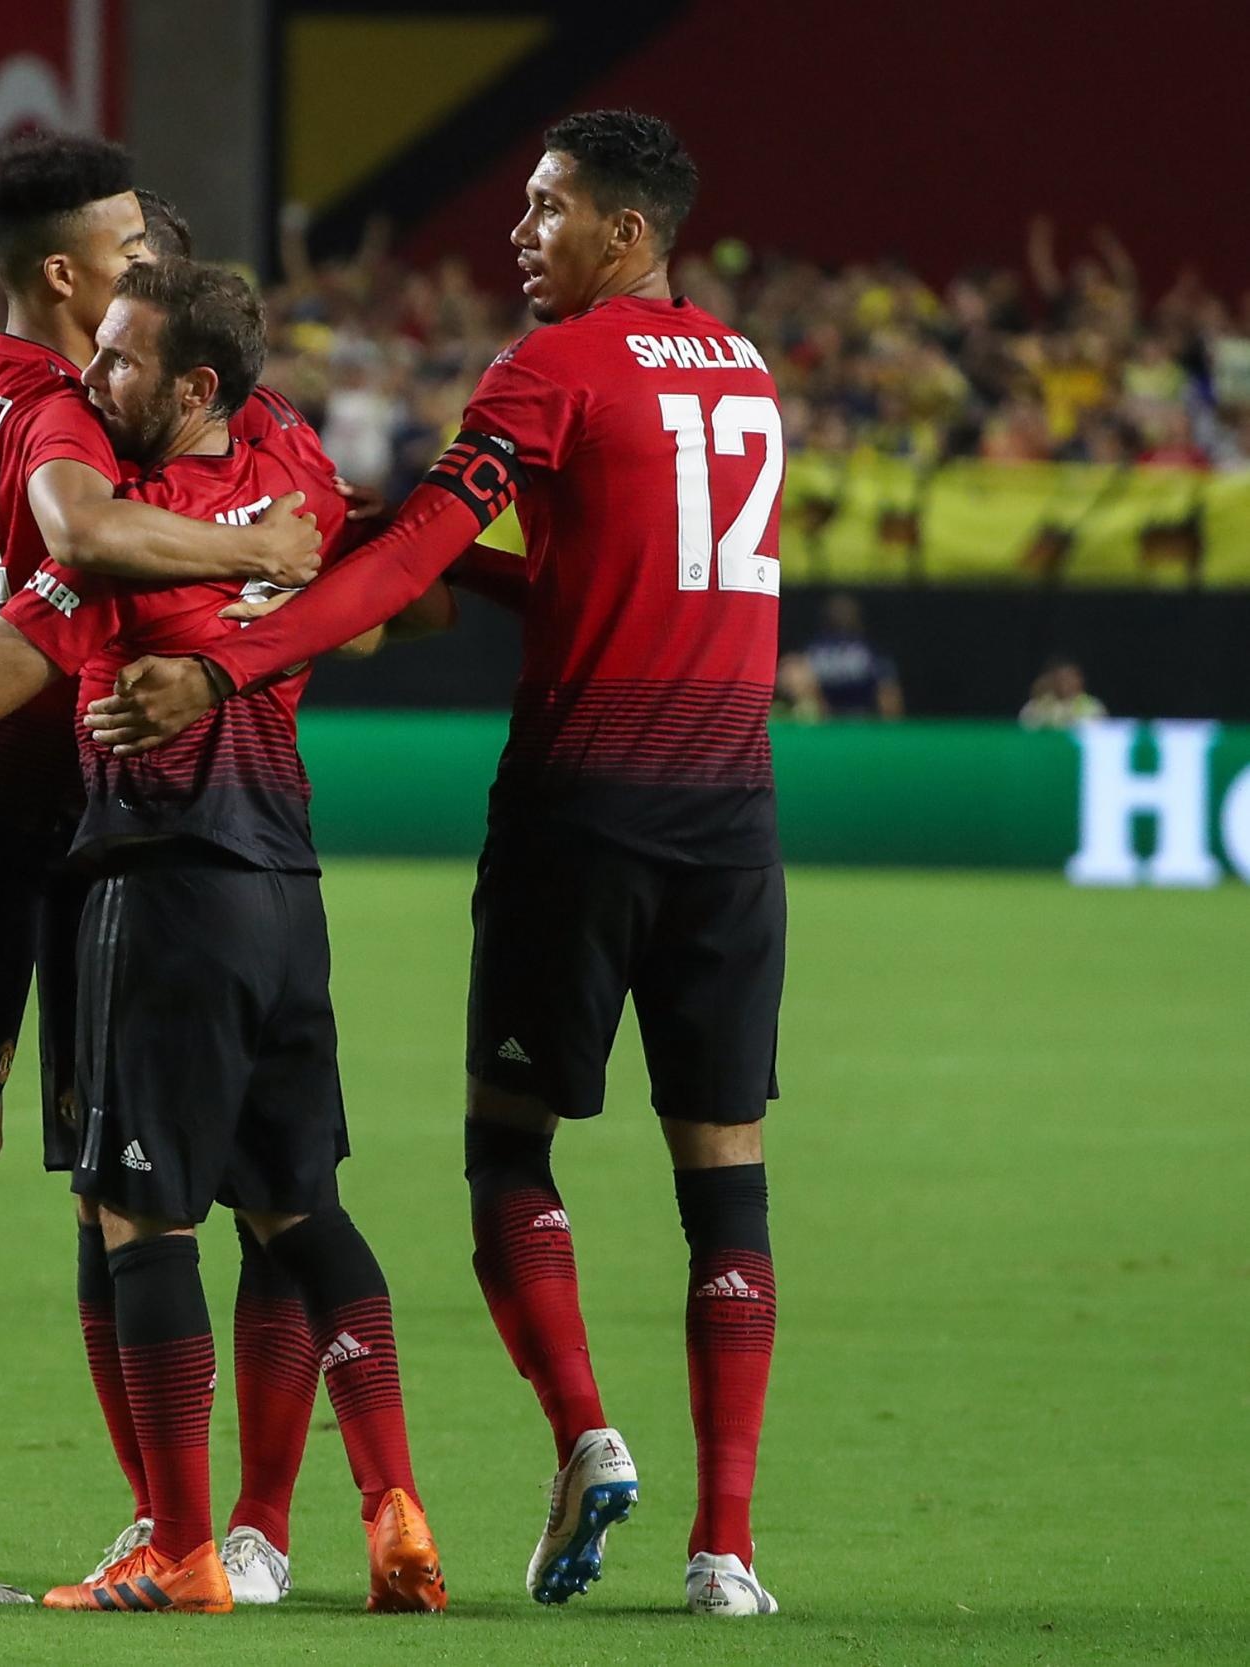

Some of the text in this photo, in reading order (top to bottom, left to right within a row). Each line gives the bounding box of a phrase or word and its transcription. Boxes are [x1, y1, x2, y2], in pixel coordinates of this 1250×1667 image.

[626, 334, 768, 374] SMALLIN
[657, 393, 783, 597] 12
[1064, 716, 1250, 888] H
[696, 1286, 759, 1299] adidas
[321, 1347, 371, 1371] adidas
